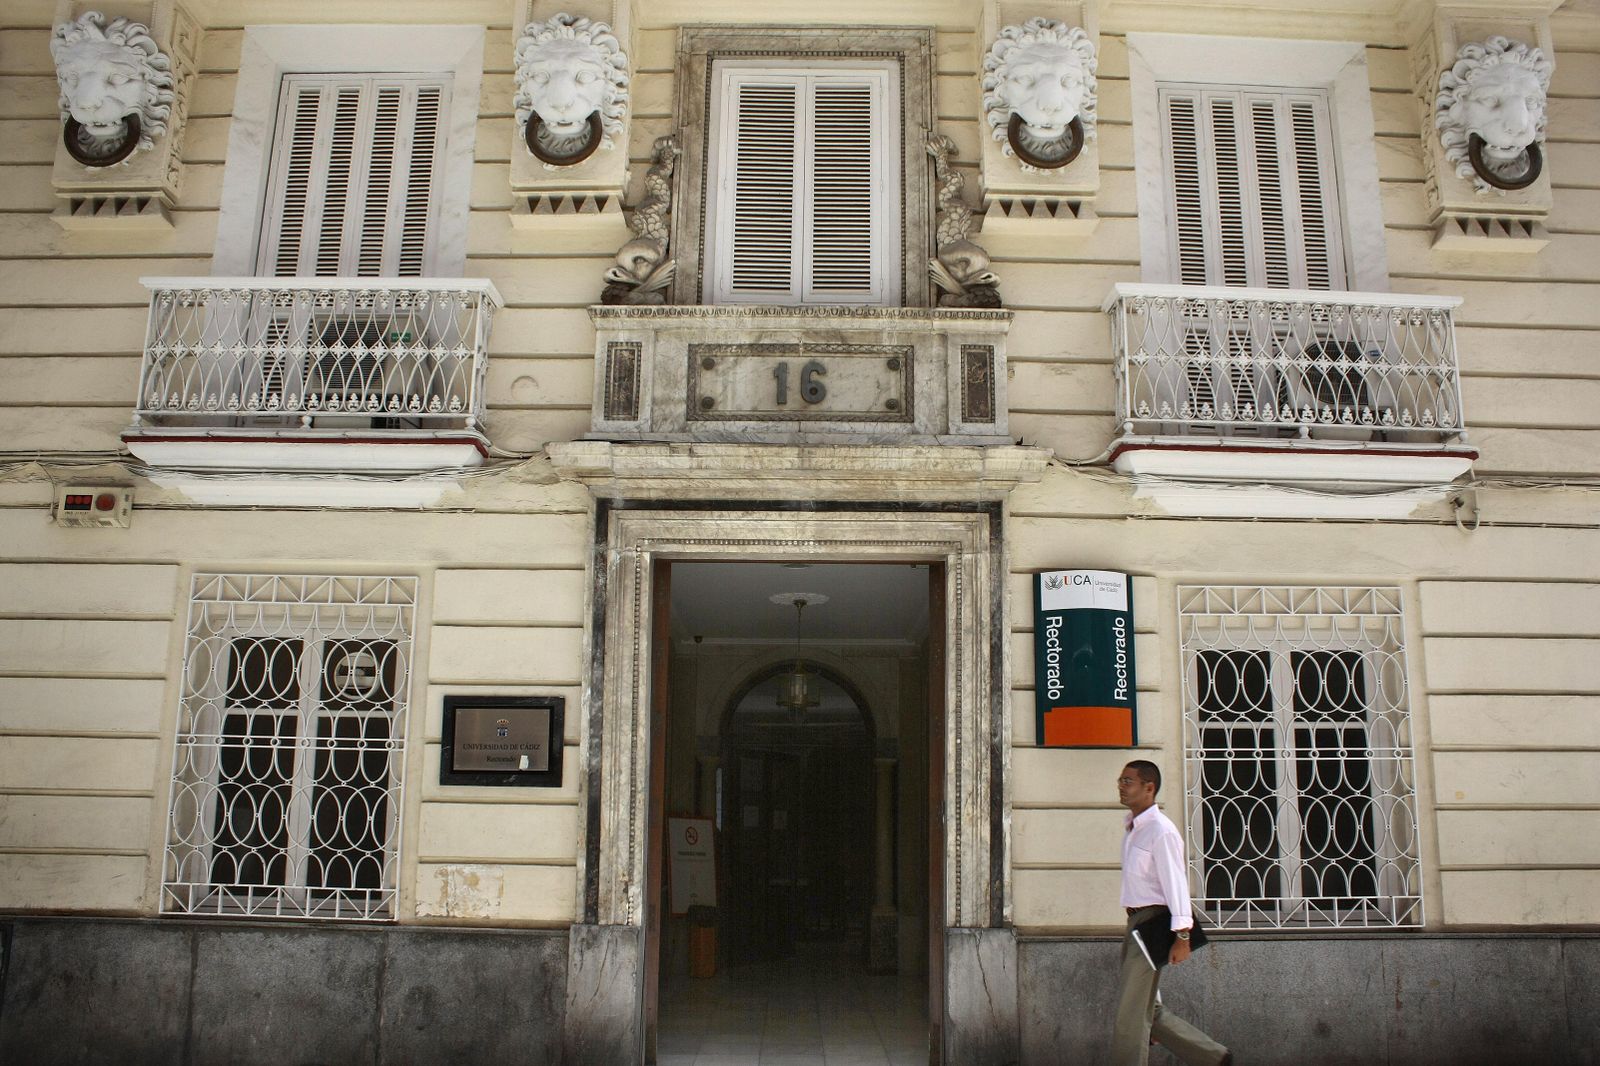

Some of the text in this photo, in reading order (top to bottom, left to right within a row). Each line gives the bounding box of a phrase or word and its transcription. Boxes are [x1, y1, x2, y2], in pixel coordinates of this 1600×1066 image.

[773, 361, 826, 405] 16
[1063, 575, 1092, 586] UCA
[1095, 580, 1121, 588] Universidad
[1046, 616, 1064, 700] Rectorado
[1112, 617, 1128, 700] Rectorado
[462, 743, 508, 751] UNIVERSIDAD
[520, 742, 541, 751] CÁDIZ
